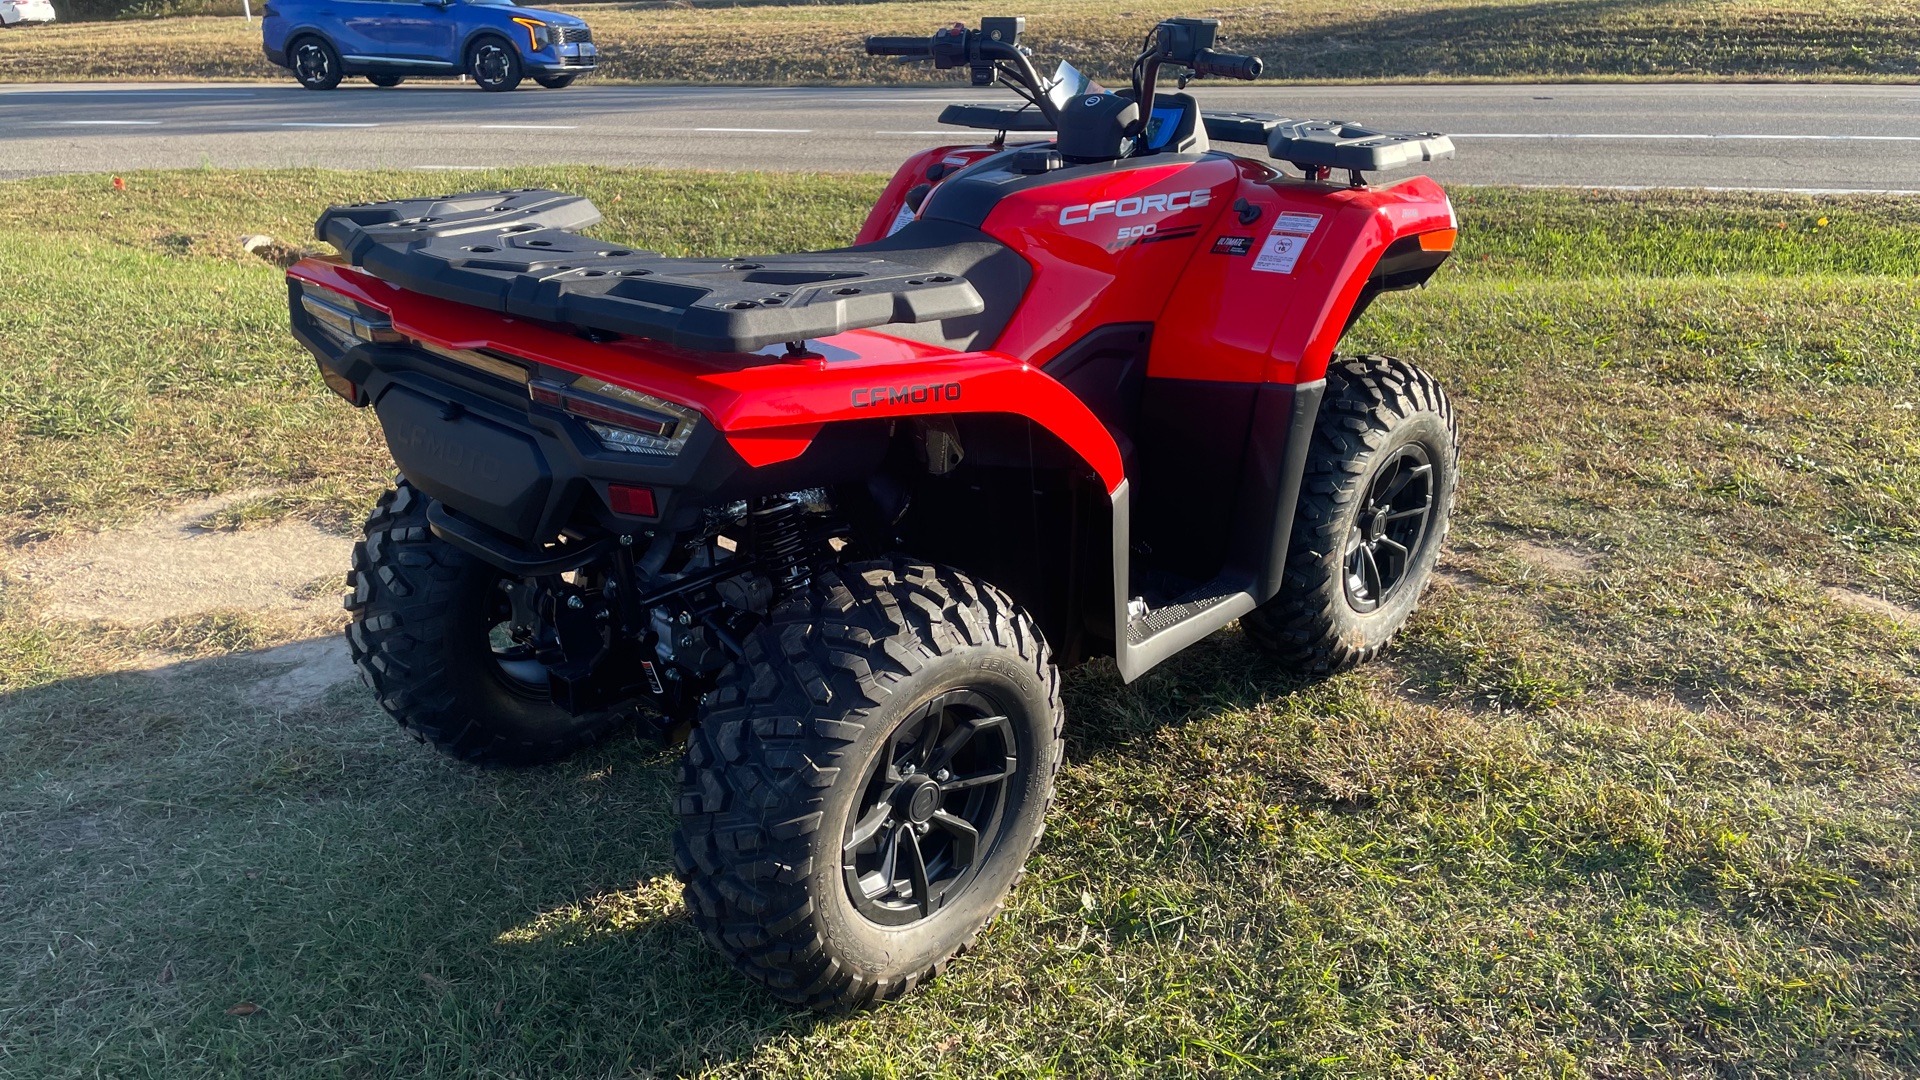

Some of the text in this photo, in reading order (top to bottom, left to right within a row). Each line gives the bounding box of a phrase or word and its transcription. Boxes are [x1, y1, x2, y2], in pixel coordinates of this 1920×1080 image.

[1059, 189, 1211, 225] CFORCE
[1117, 224, 1157, 239] 500
[851, 382, 961, 408] CFMOTO
[980, 656, 1032, 691] CFMOTO
